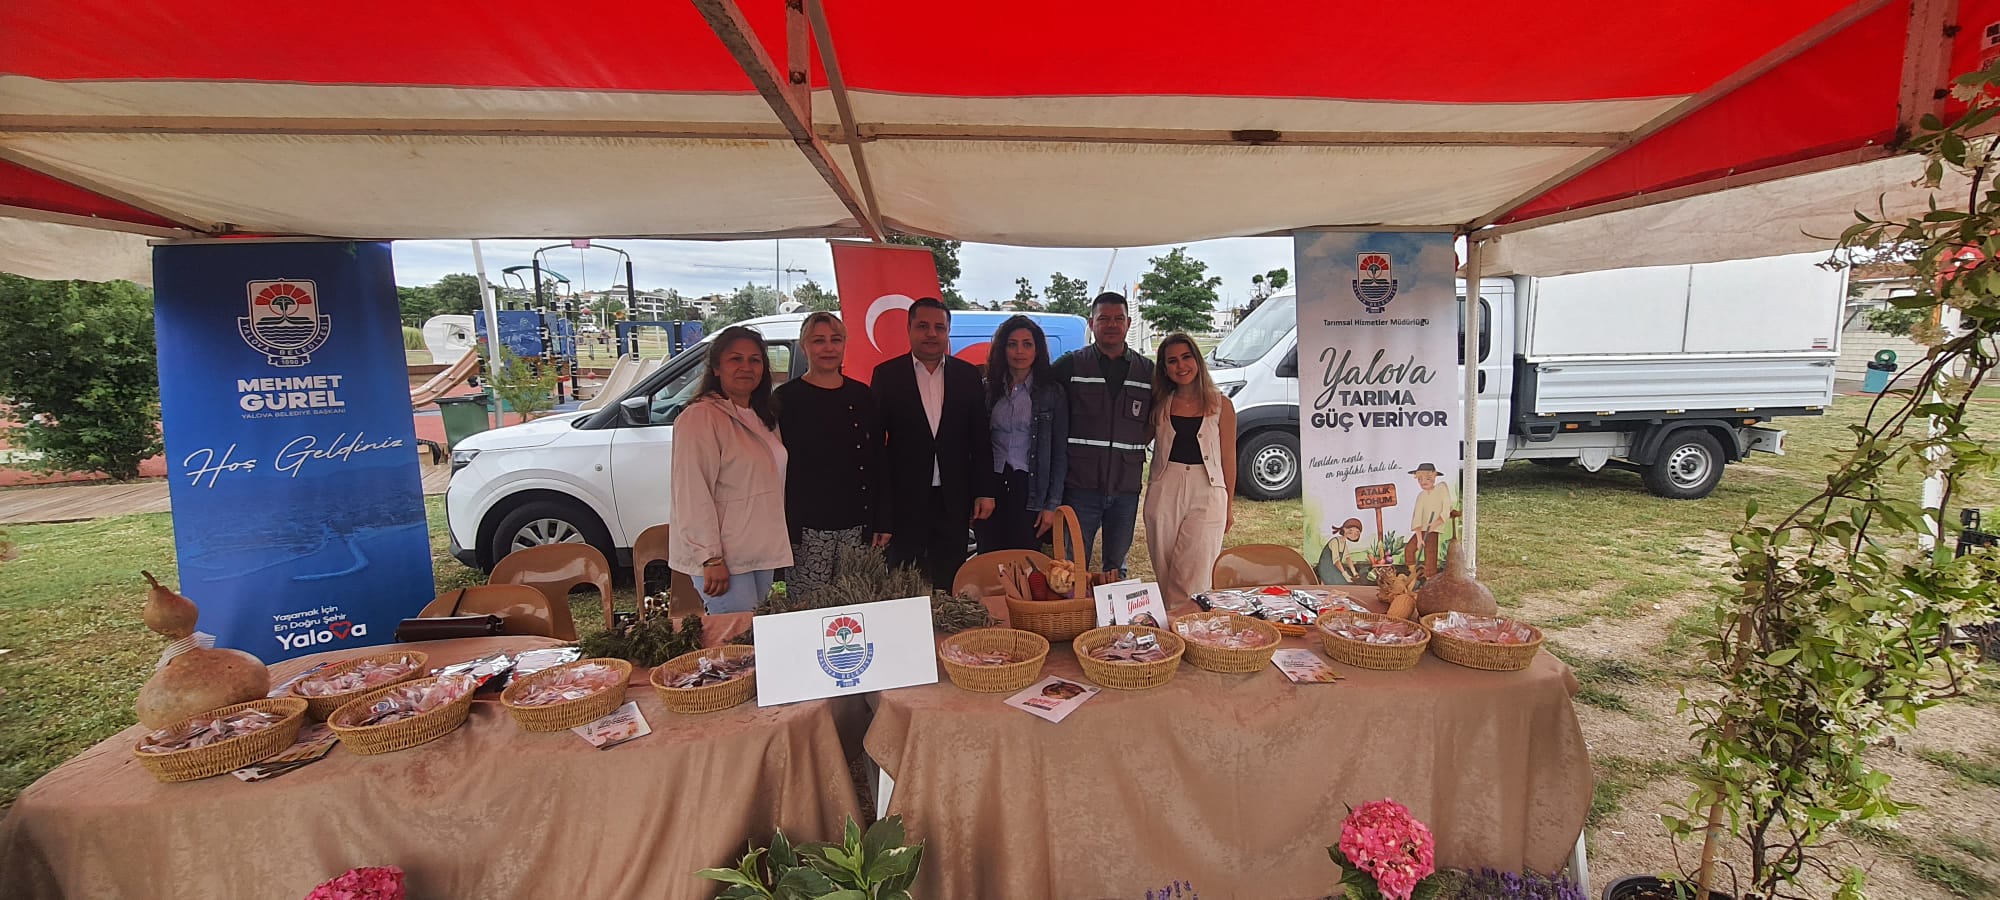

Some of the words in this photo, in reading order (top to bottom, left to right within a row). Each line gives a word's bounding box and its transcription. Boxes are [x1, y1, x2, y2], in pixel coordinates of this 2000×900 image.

[1354, 318, 1389, 326] Hizmetler
[242, 323, 270, 352] YALOVA
[237, 375, 342, 392] MEHMET
[1314, 347, 1436, 410] Yalova
[240, 390, 345, 411] GÜREL
[1338, 390, 1416, 406] TARIMA
[1311, 409, 1354, 432] GÜÇ
[1358, 407, 1448, 428] VERİYOR
[183, 443, 257, 488] Hoş
[274, 431, 403, 478] Geldiniz
[1361, 487, 1391, 496] ATALIK
[1360, 496, 1393, 506] TOHUM
[273, 608, 319, 621] Yaşamak
[321, 605, 338, 614] İçin
[274, 624, 288, 632] En
[290, 619, 321, 629] Doğru
[322, 613, 347, 624] Şehir
